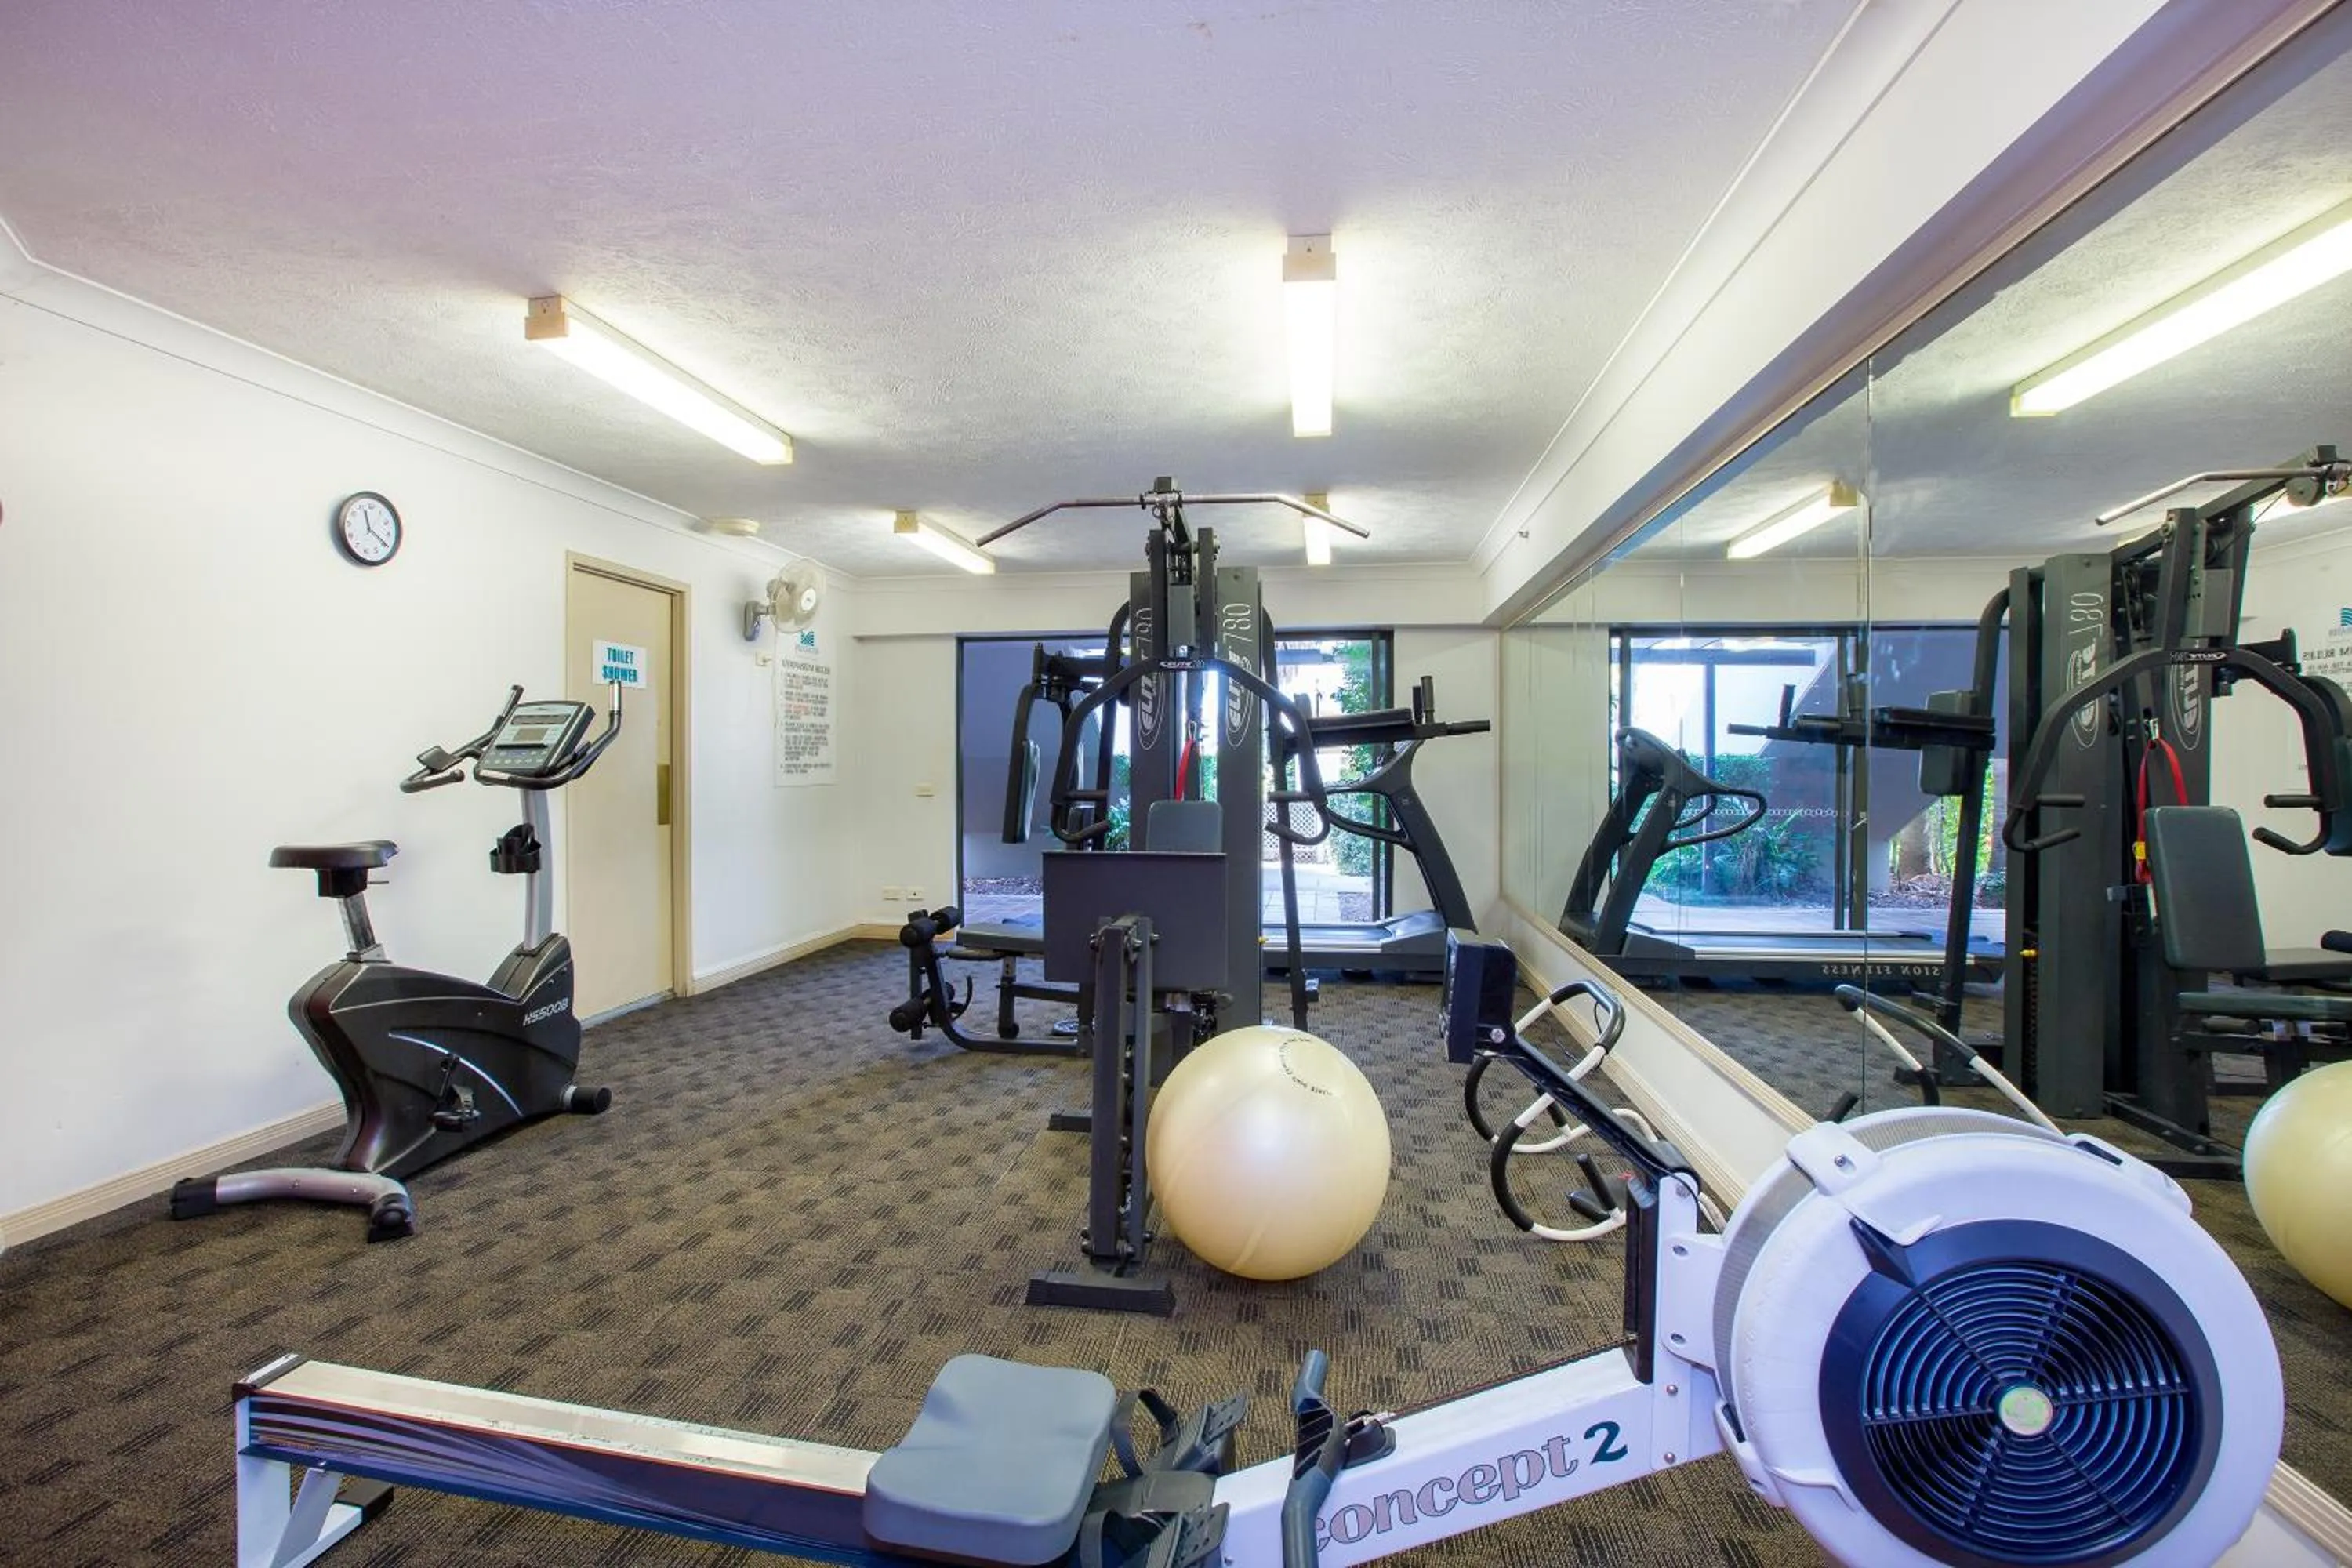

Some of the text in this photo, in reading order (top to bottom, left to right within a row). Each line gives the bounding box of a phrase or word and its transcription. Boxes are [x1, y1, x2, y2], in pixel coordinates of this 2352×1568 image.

[1222, 603, 1253, 644] 780
[607, 647, 634, 664] TOILET
[602, 665, 637, 682] SHOWER
[1584, 1421, 1628, 1465] 2
